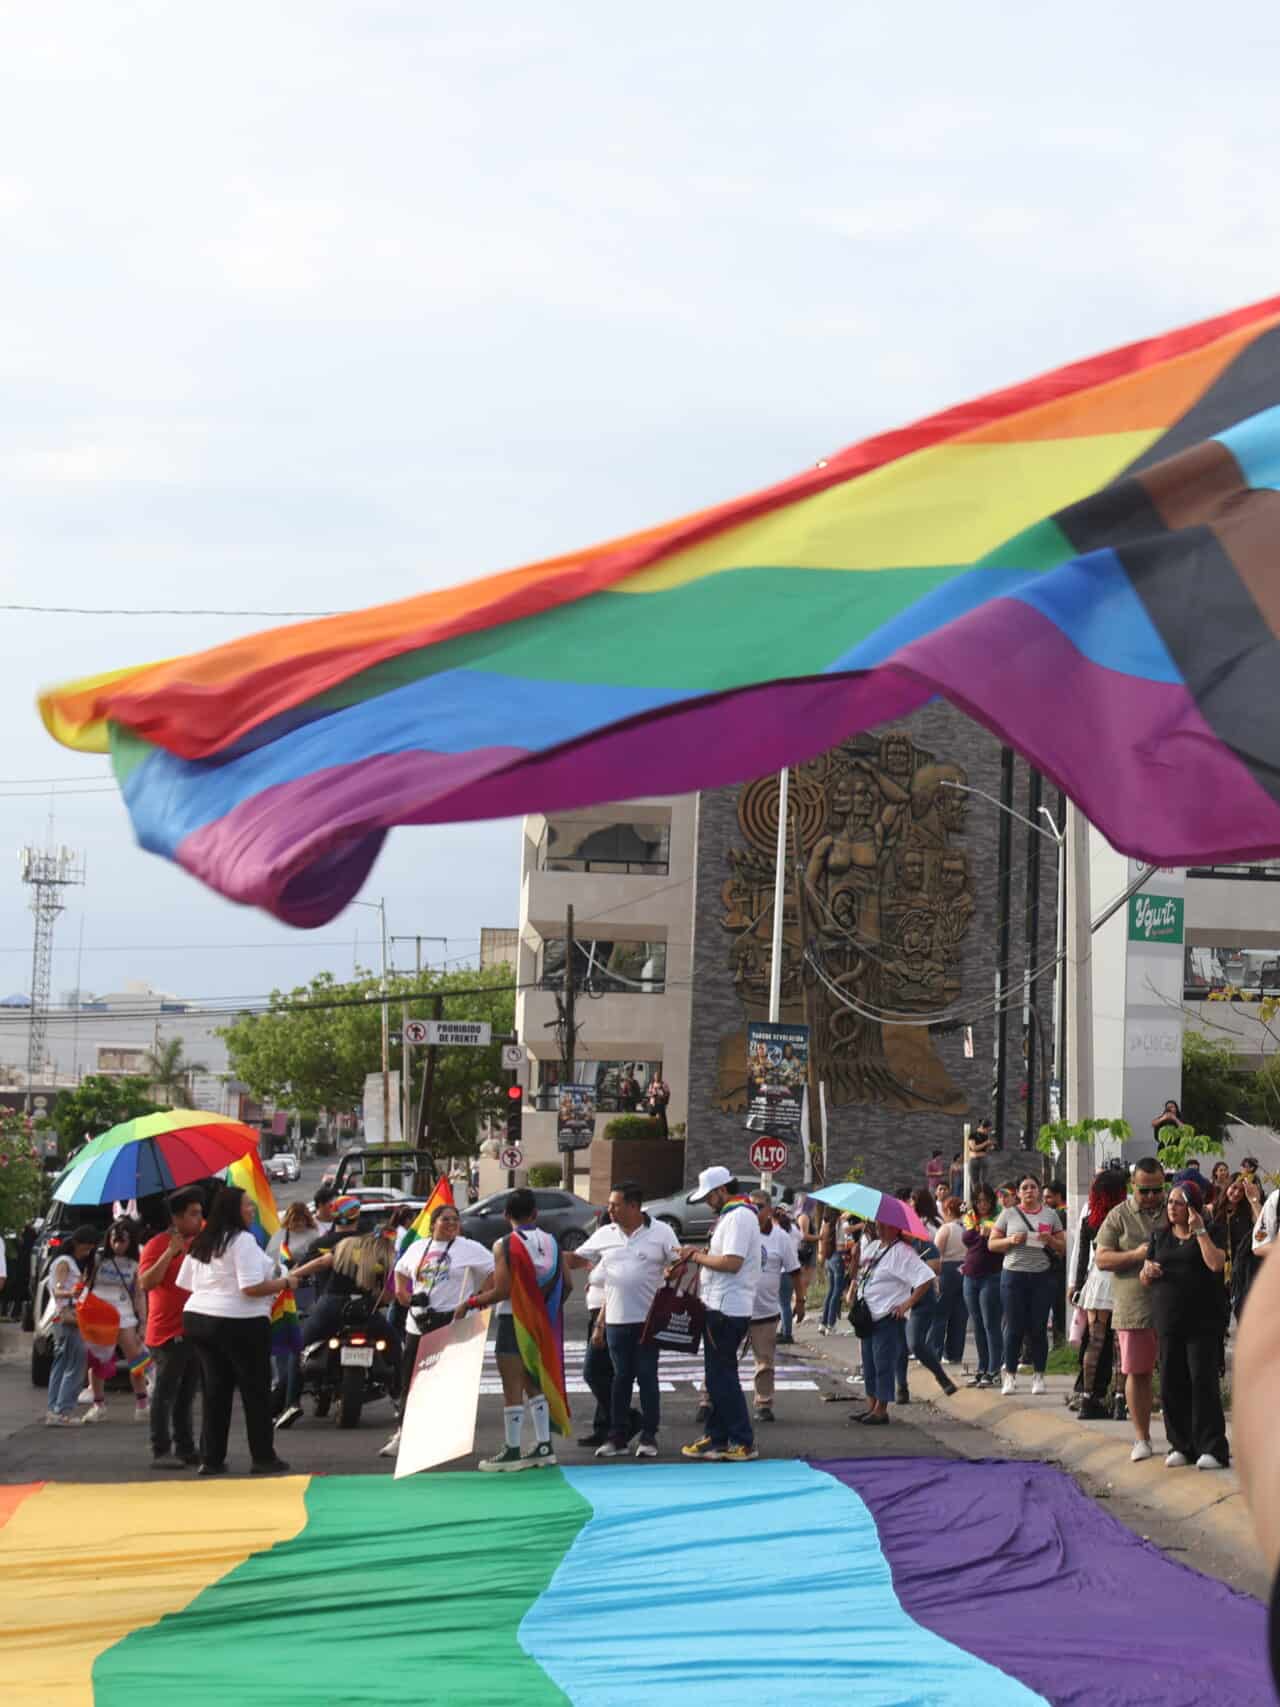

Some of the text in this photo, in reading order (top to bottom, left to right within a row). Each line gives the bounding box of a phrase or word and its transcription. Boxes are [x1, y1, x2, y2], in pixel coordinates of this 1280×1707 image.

[437, 1024, 481, 1033] PROHIBIDO
[440, 1033, 478, 1043] DE FRENTE
[753, 1146, 784, 1162] ALTO
